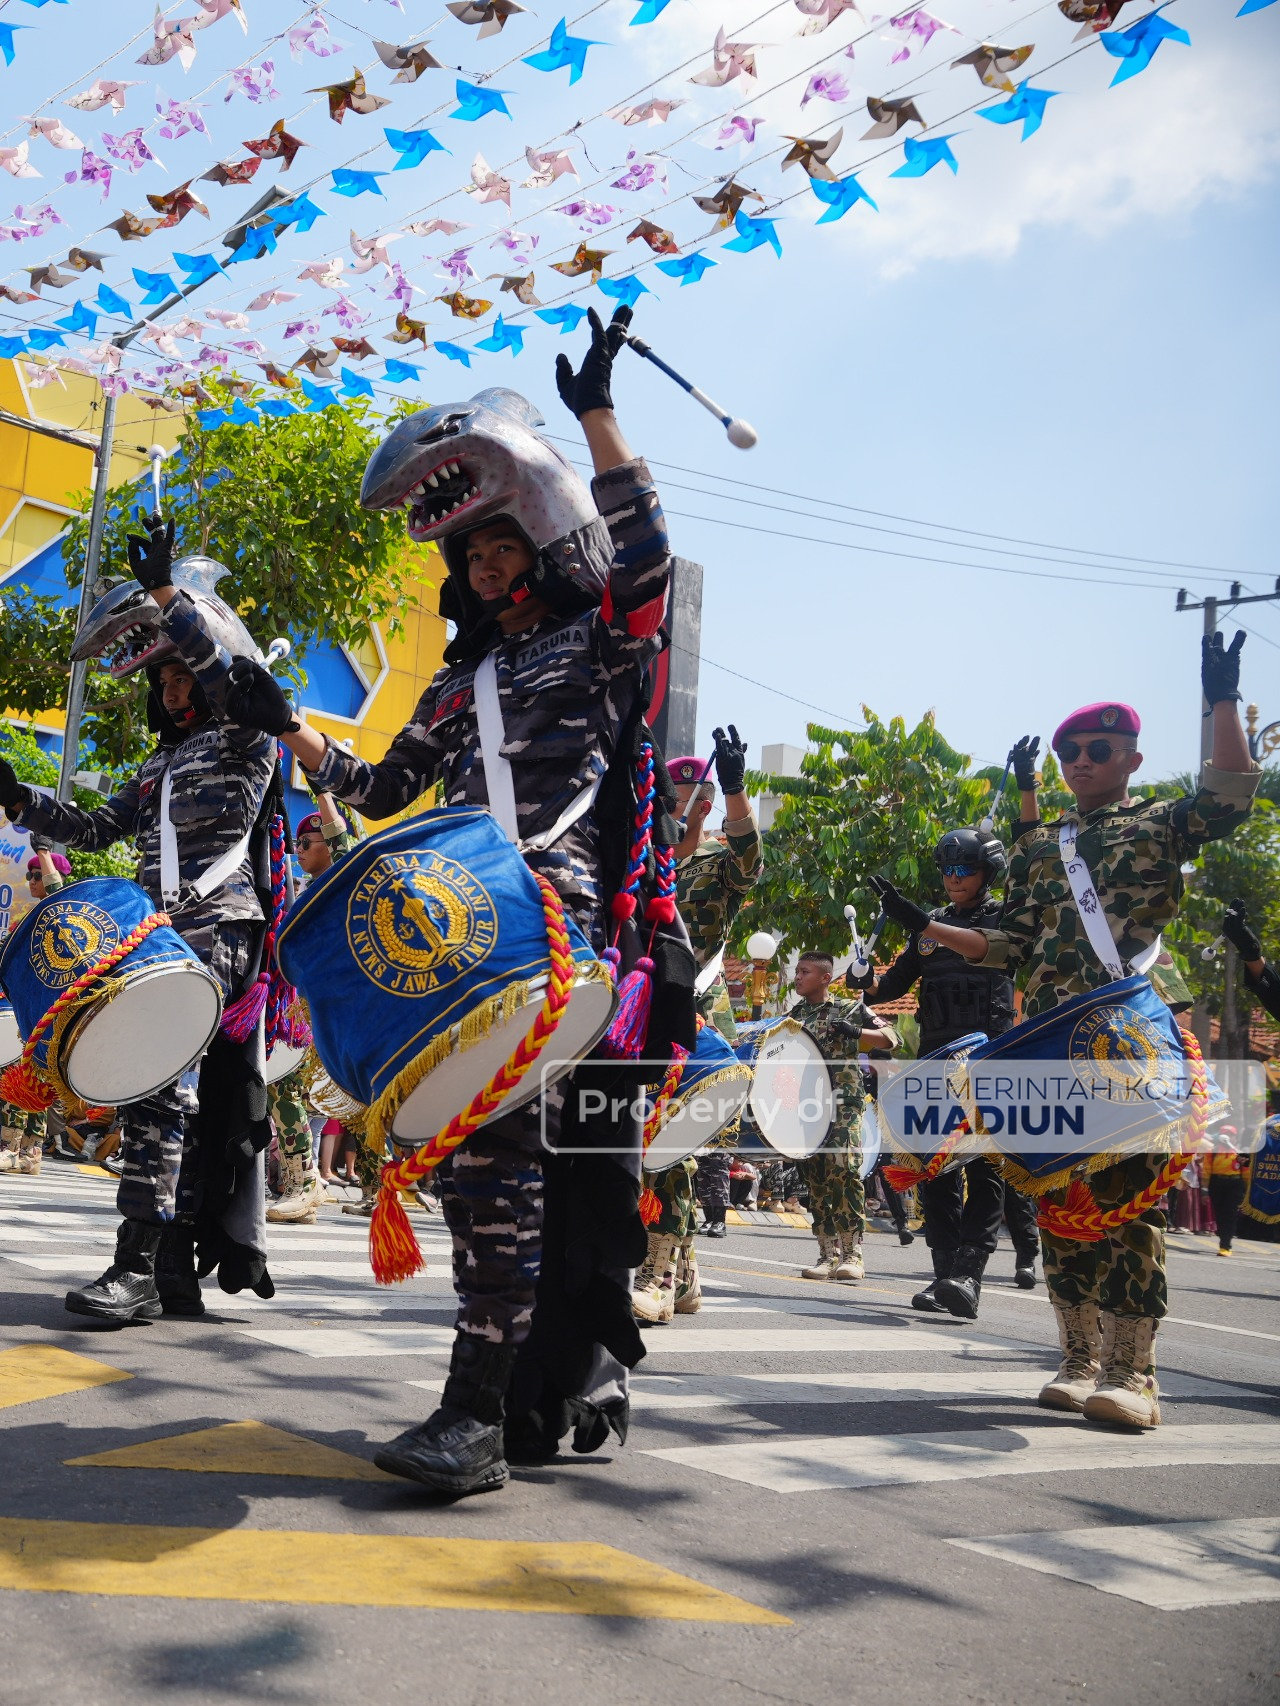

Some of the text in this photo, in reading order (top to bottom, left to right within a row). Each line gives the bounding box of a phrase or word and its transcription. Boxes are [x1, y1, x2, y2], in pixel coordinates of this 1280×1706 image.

[519, 629, 585, 664] TARUNA
[178, 735, 213, 755] TARUNA
[1031, 831, 1060, 843] JAS
[356, 855, 421, 903] TARUNA
[428, 857, 491, 912] MADANI
[685, 864, 715, 878] FOX 7
[35, 904, 73, 937] TARUNA
[79, 904, 116, 934] MADANI
[353, 930, 388, 978] SMAN
[390, 920, 494, 992] JAWA TIMUR
[1079, 1007, 1125, 1035] TARUNA
